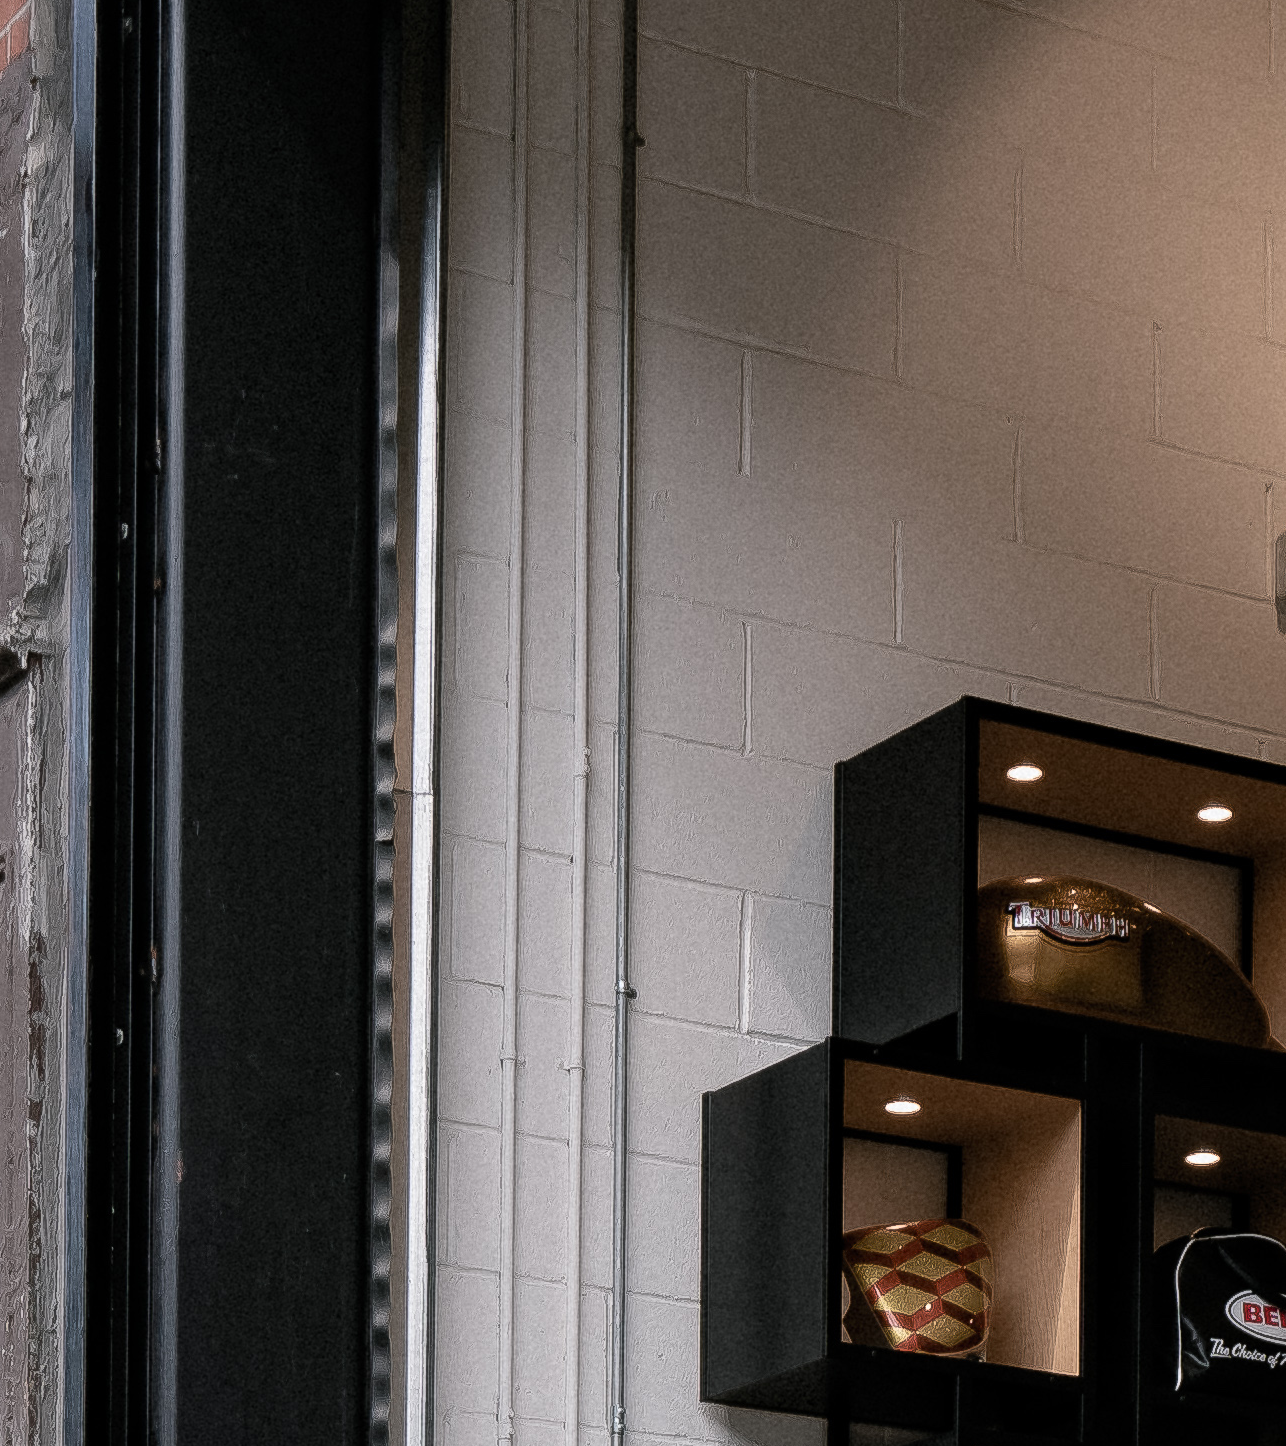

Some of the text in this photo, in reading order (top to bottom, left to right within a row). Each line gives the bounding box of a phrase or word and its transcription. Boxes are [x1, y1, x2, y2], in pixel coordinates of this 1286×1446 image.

[1009, 902, 1129, 939] TRIUMPH
[1210, 1338, 1231, 1358] The
[1231, 1343, 1266, 1363] Choice
[1267, 1352, 1281, 1369] of
